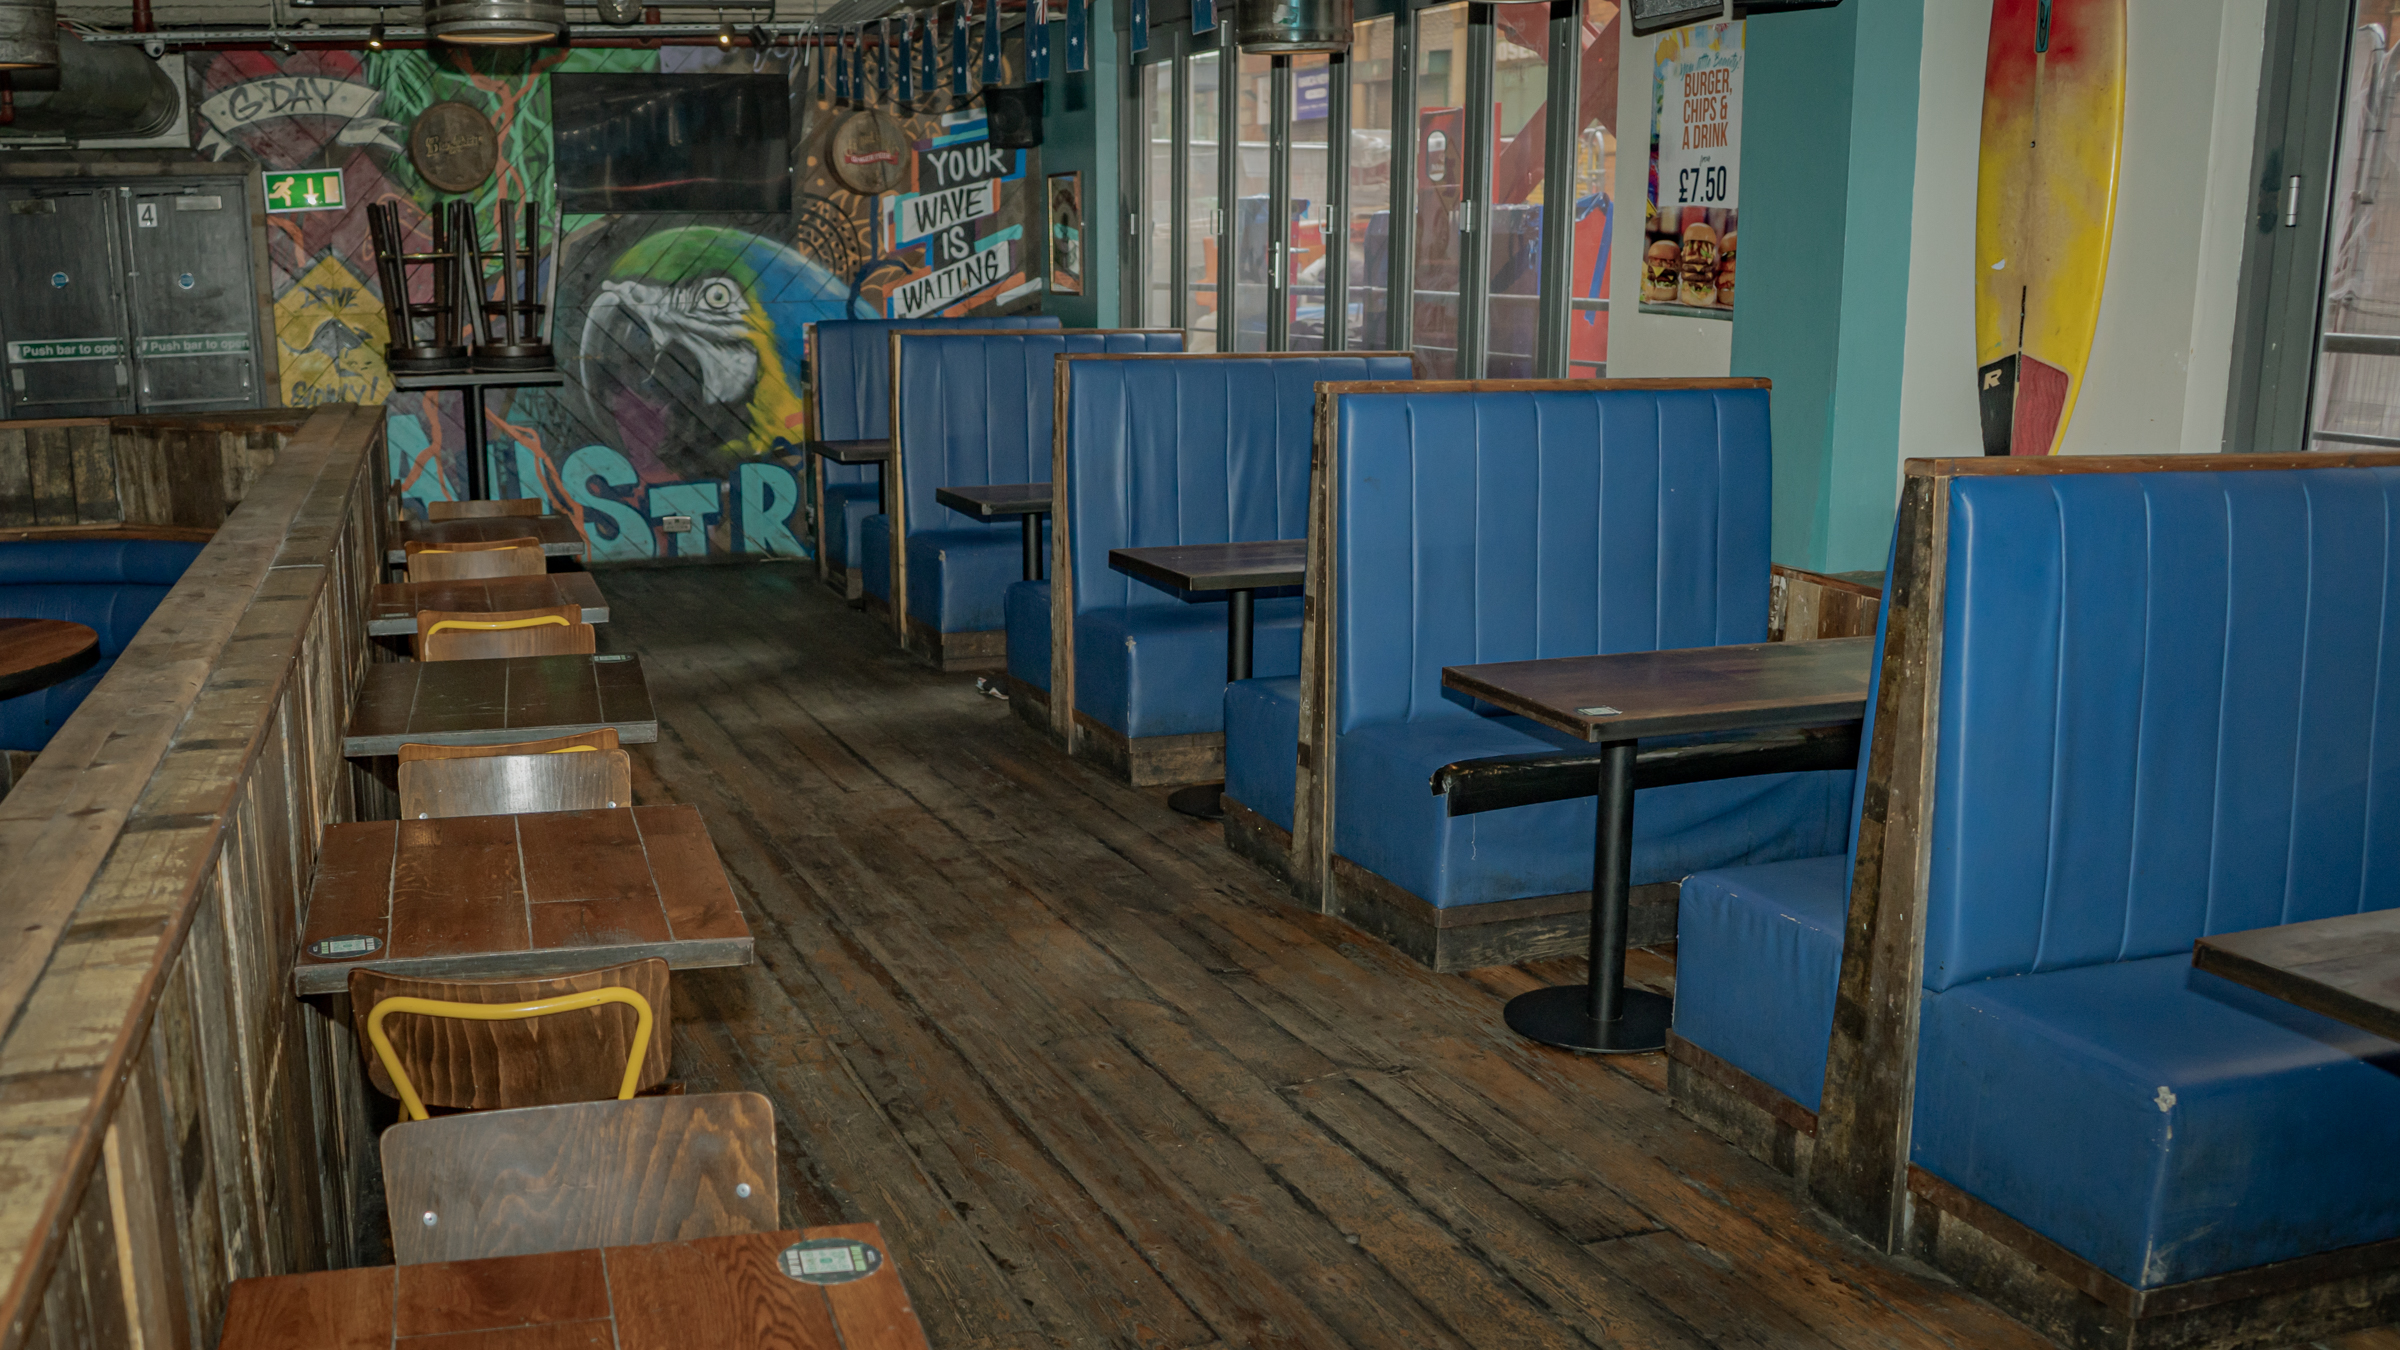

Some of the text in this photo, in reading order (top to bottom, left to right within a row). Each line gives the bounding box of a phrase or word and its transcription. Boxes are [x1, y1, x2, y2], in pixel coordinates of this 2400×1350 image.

[1684, 67, 1733, 98] BURGER,
[1683, 95, 1728, 124] CHIPS &
[1682, 122, 1728, 150] A DRINK
[927, 142, 1007, 186] YOUR
[1678, 165, 1727, 203] £7.50
[142, 205, 154, 225] 4
[915, 186, 987, 233] WAVE
[941, 225, 970, 260] IS
[902, 249, 998, 313] WAITING
[23, 344, 53, 356] Push
[56, 344, 76, 355] bar
[79, 344, 91, 354] to
[150, 339, 249, 352] Push bar to open
[1983, 368, 2002, 391] R
